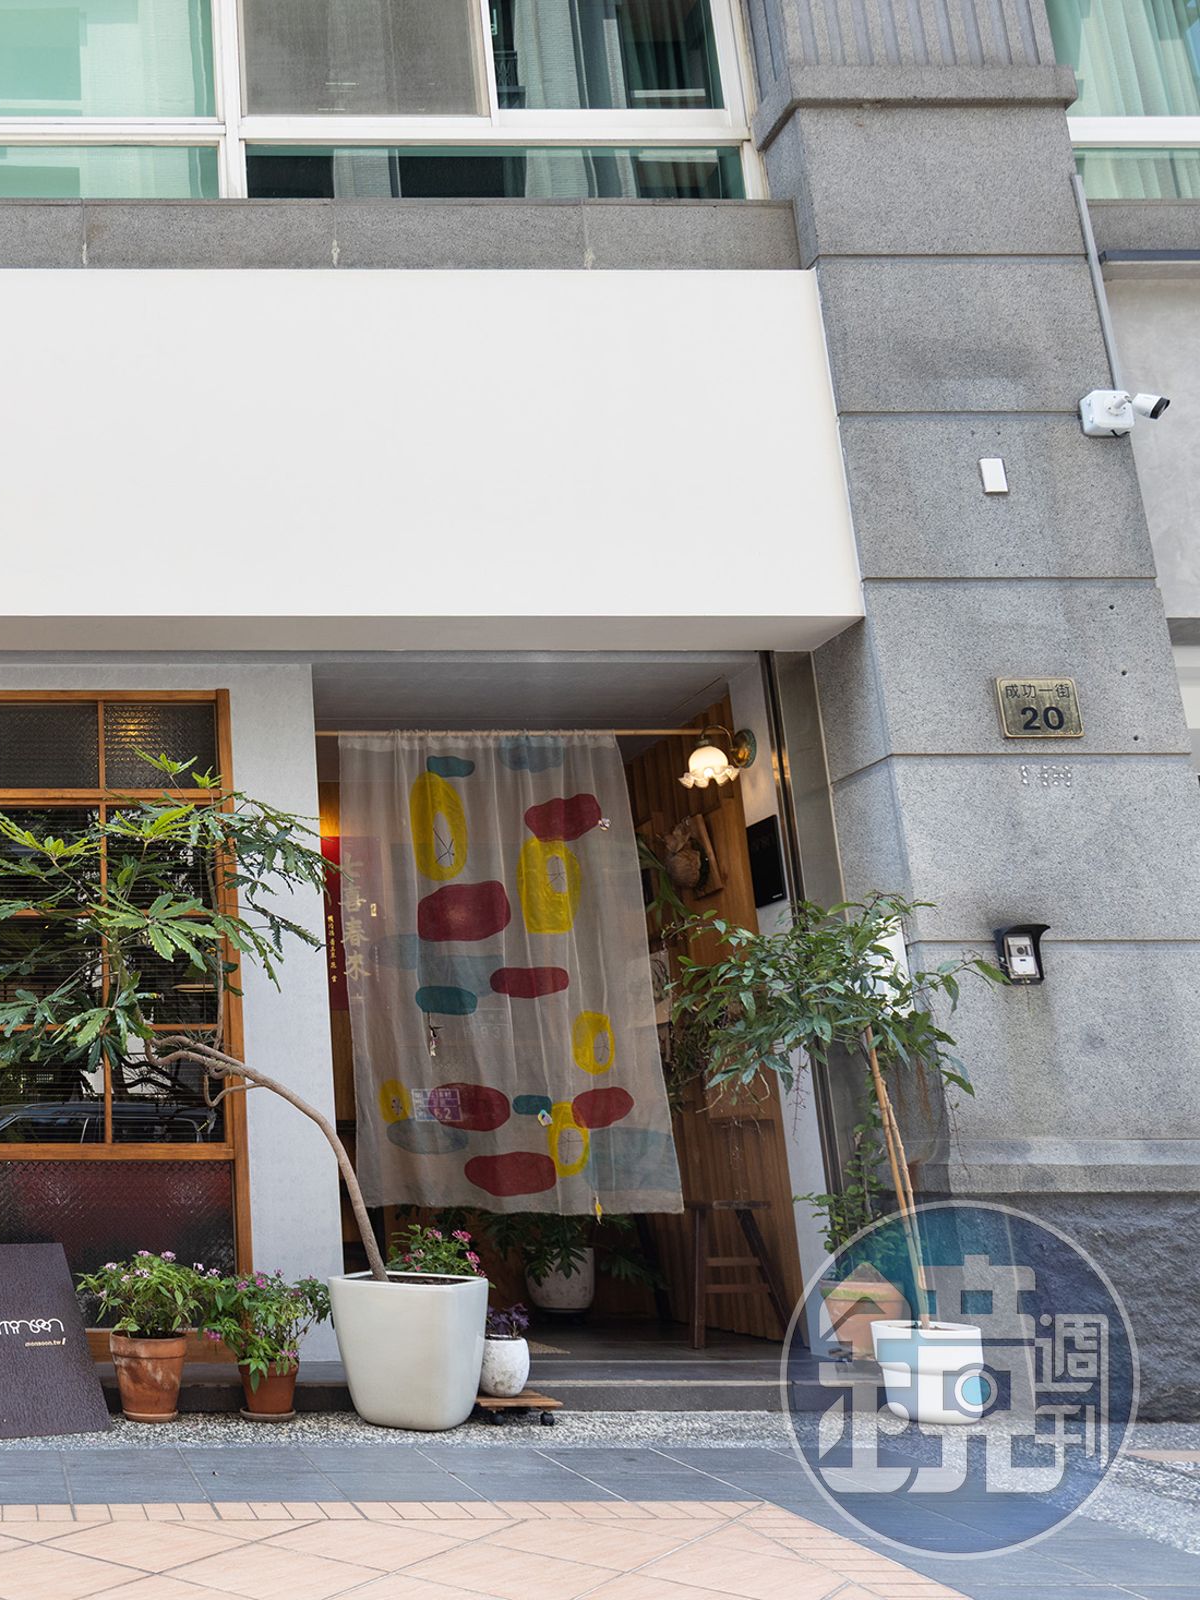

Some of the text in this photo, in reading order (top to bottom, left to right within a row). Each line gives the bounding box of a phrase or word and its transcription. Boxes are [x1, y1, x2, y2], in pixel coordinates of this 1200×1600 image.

[1005, 684, 1071, 699] 成功一街
[1021, 706, 1065, 731] 20
